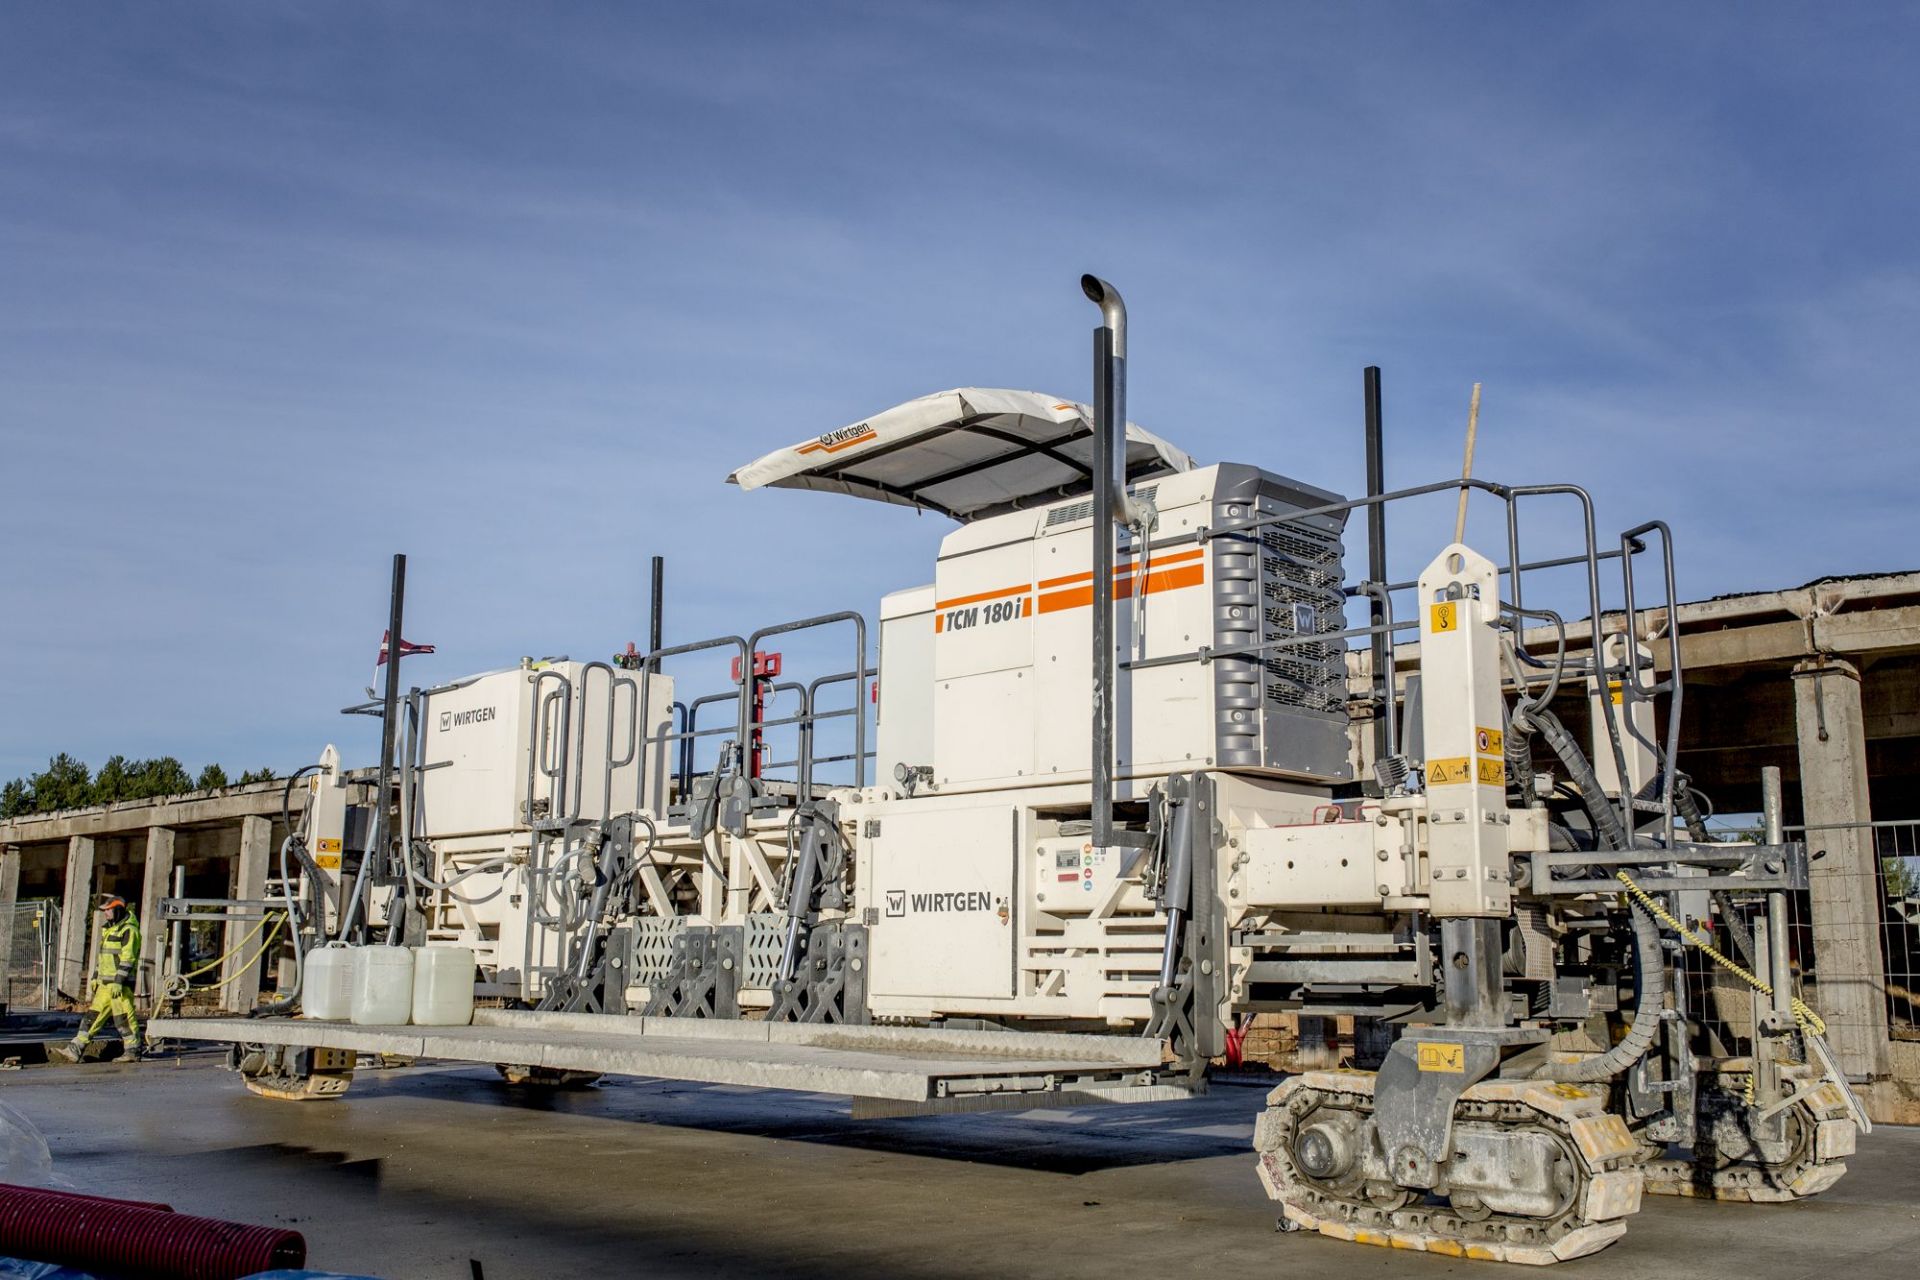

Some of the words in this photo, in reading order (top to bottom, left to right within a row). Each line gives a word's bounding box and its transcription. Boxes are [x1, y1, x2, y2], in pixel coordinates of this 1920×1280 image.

[832, 422, 870, 441] Wirtgen
[946, 607, 979, 631] TCM
[454, 706, 496, 727] WIRTGEN
[911, 891, 991, 912] WIRTGEN
